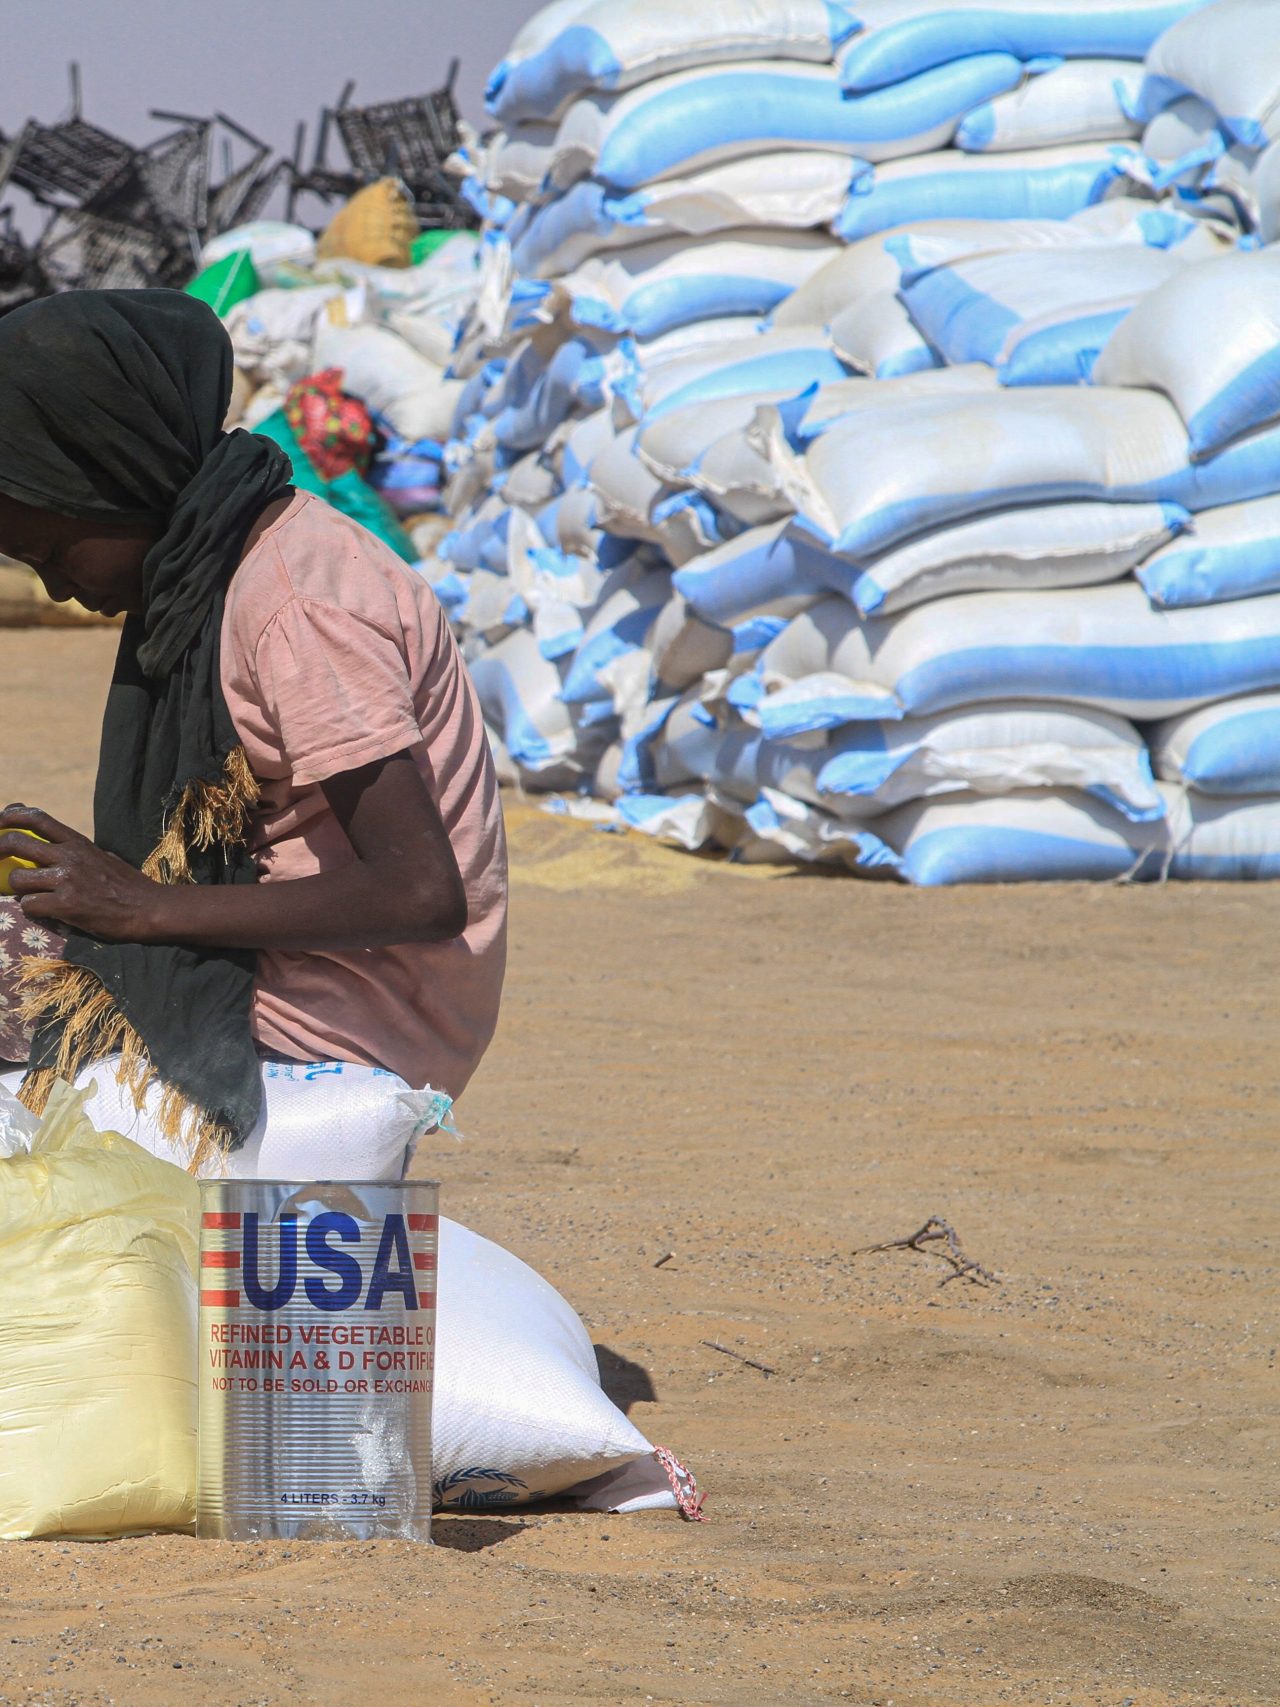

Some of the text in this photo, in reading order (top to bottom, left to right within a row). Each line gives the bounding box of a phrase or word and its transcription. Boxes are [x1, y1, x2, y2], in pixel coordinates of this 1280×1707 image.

[243, 1211, 418, 1311] USA
[211, 1324, 292, 1344] REFINED
[298, 1325, 423, 1345] VEGETABLE
[210, 1349, 283, 1369] VITAMIN
[290, 1351, 307, 1370] A
[313, 1351, 331, 1370] &
[339, 1352, 355, 1370] D
[212, 1377, 234, 1391] NOT
[239, 1378, 258, 1392] TO
[263, 1379, 284, 1392] BE
[291, 1379, 338, 1393] SOLD
[345, 1379, 368, 1393] OR
[280, 1493, 287, 1504] 4
[292, 1493, 339, 1504] LITERS
[351, 1494, 368, 1504] 3.7
[372, 1494, 386, 1506] kg
